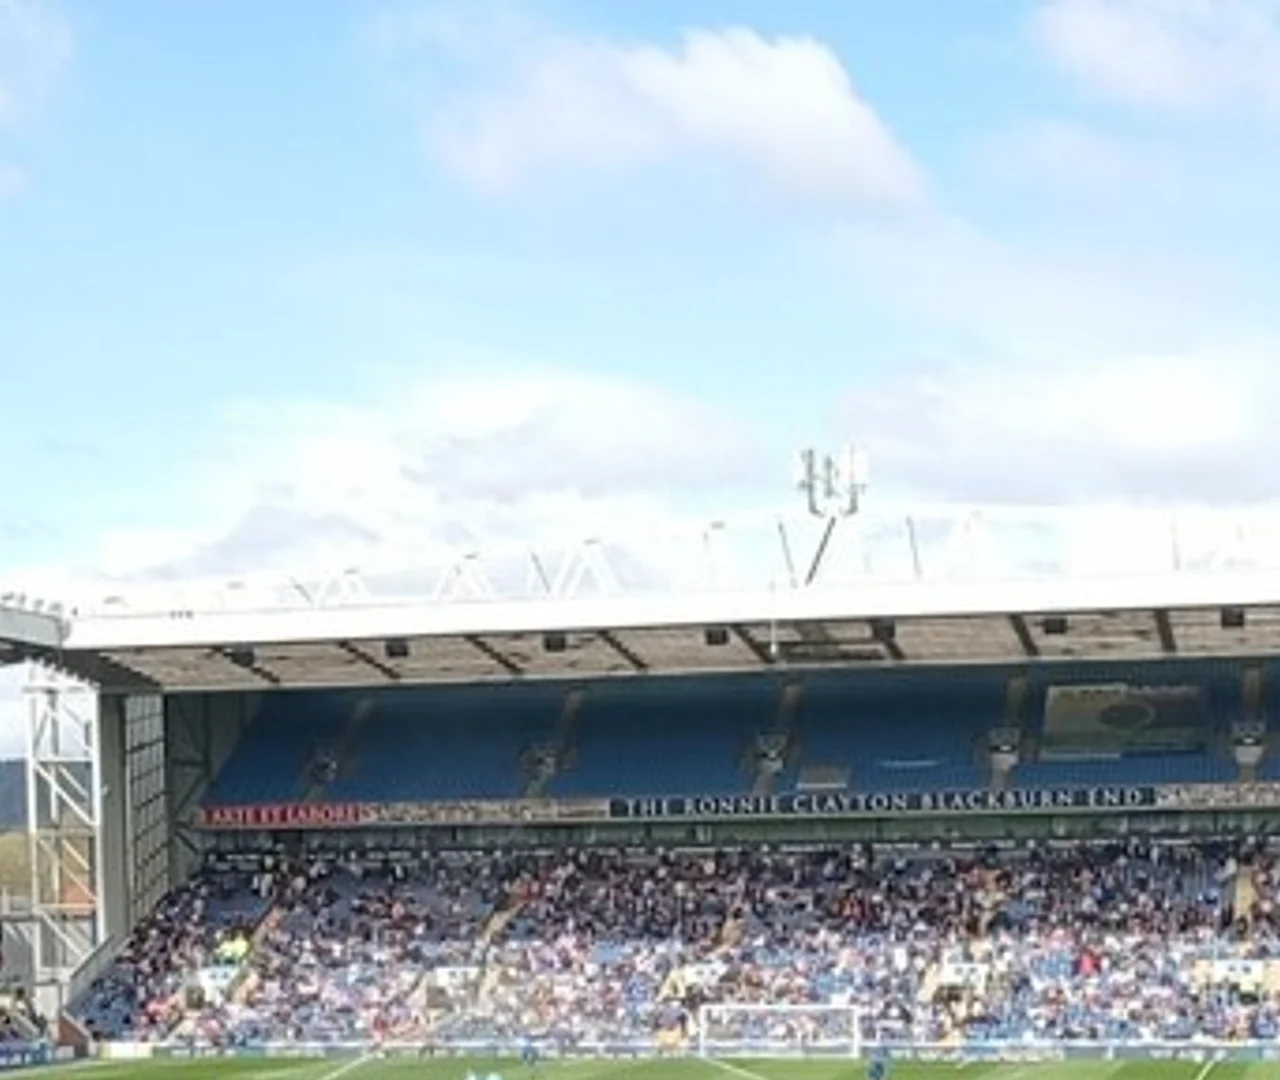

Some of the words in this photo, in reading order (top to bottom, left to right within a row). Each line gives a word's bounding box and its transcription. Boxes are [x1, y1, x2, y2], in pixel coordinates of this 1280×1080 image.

[627, 798, 668, 817] THE
[684, 796, 777, 817] RONNIE
[792, 792, 908, 813] CLAYTON
[920, 787, 1072, 811] BLACKBURN
[1088, 786, 1140, 807] END
